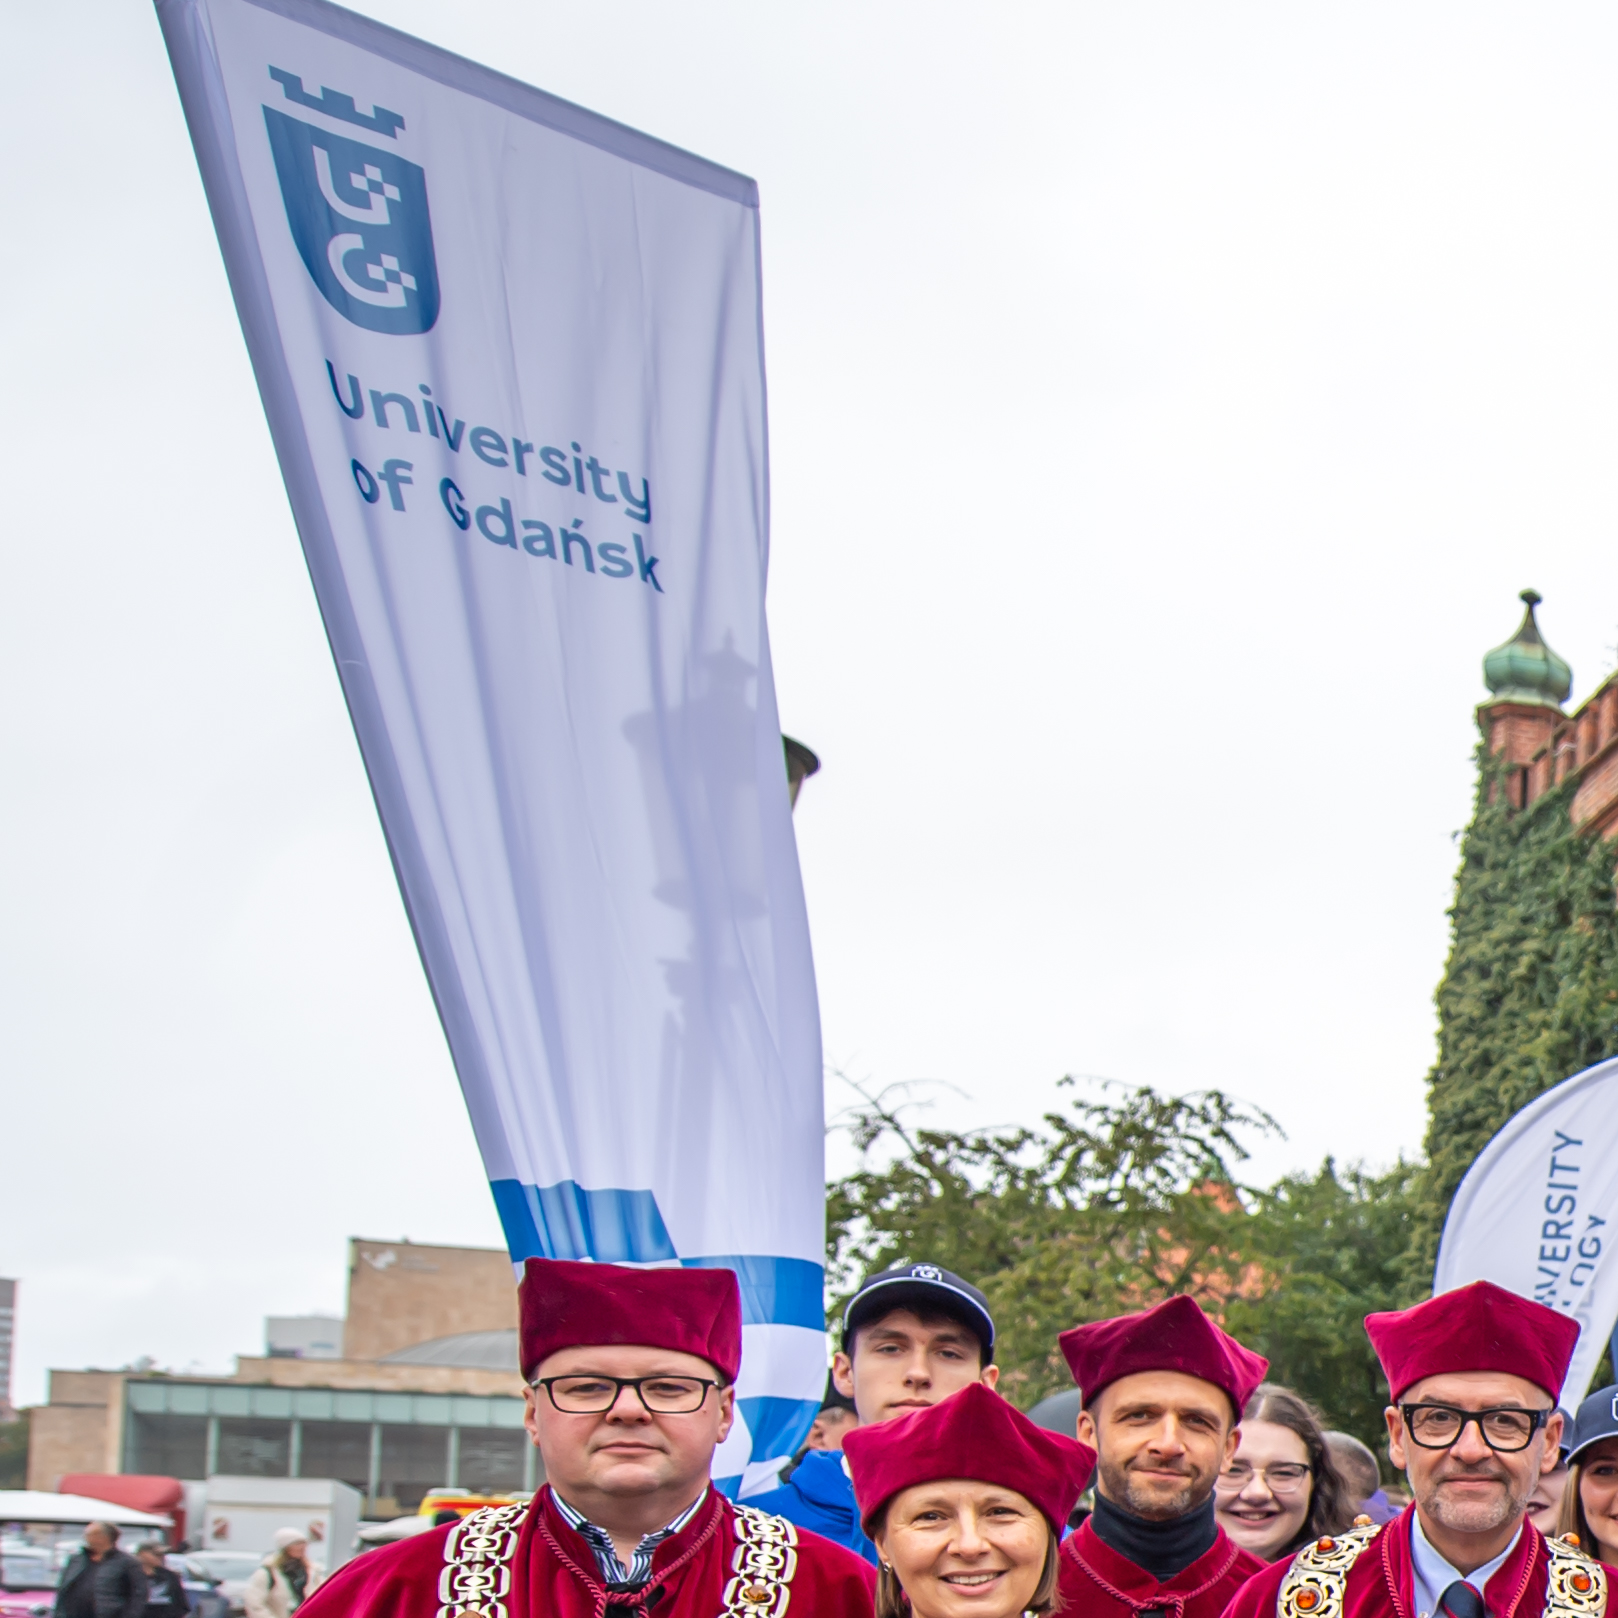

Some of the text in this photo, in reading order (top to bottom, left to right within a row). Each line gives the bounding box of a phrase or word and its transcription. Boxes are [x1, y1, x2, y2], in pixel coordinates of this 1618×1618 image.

[325, 357, 652, 524] University
[350, 458, 665, 593] of Gdańsk
